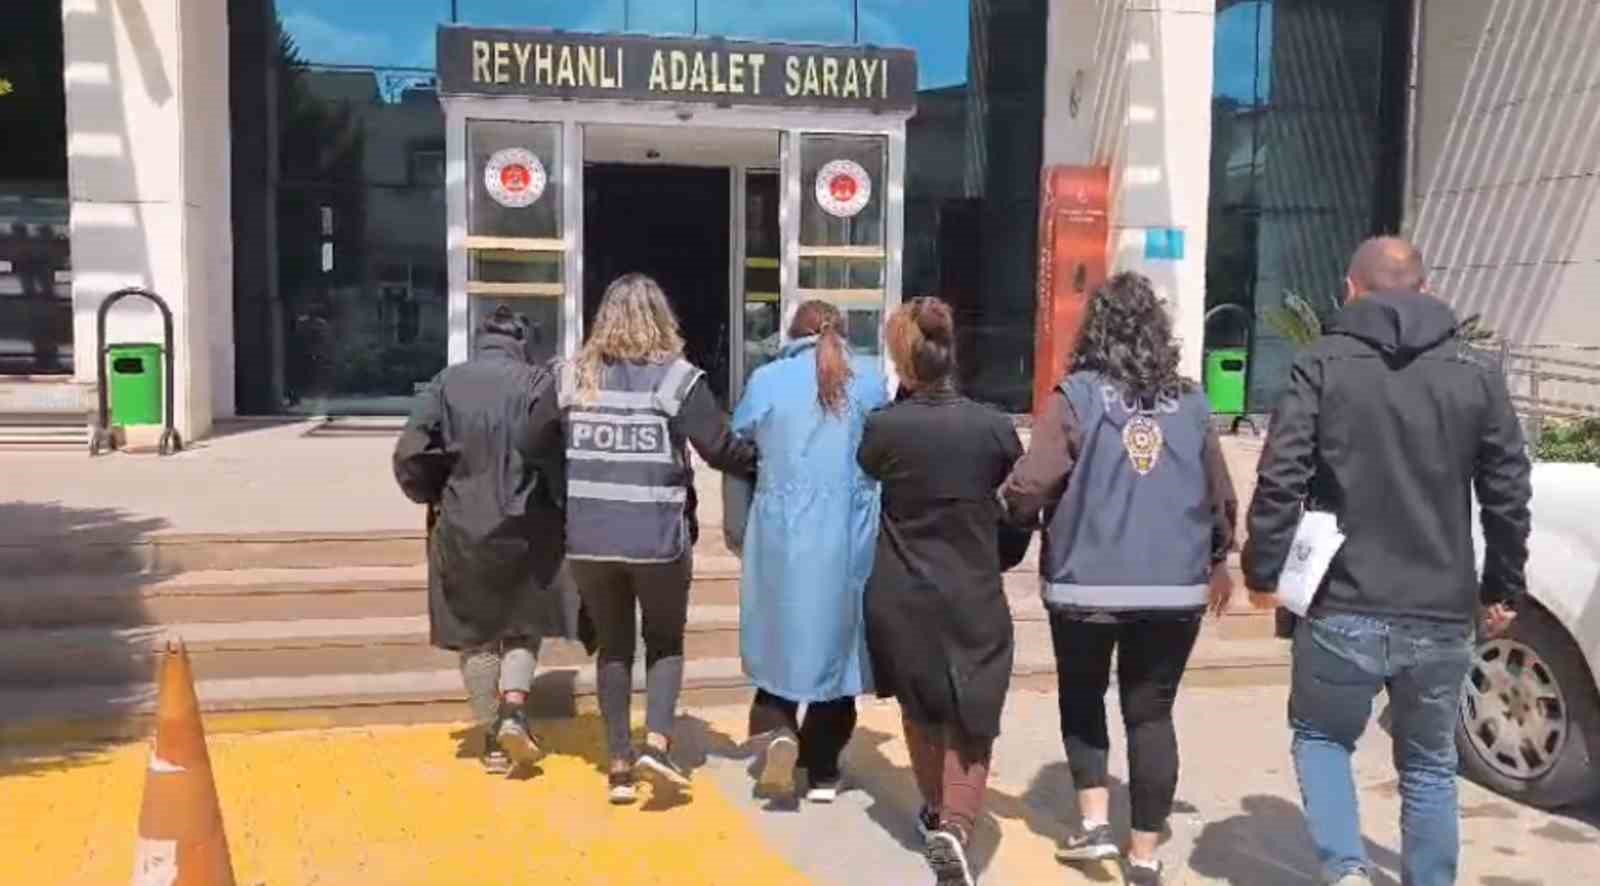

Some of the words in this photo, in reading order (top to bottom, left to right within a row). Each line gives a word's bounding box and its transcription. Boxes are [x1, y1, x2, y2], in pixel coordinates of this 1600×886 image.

[472, 40, 624, 88] REYHANLI
[649, 49, 765, 95] ADALET
[784, 55, 888, 99] SARAYI
